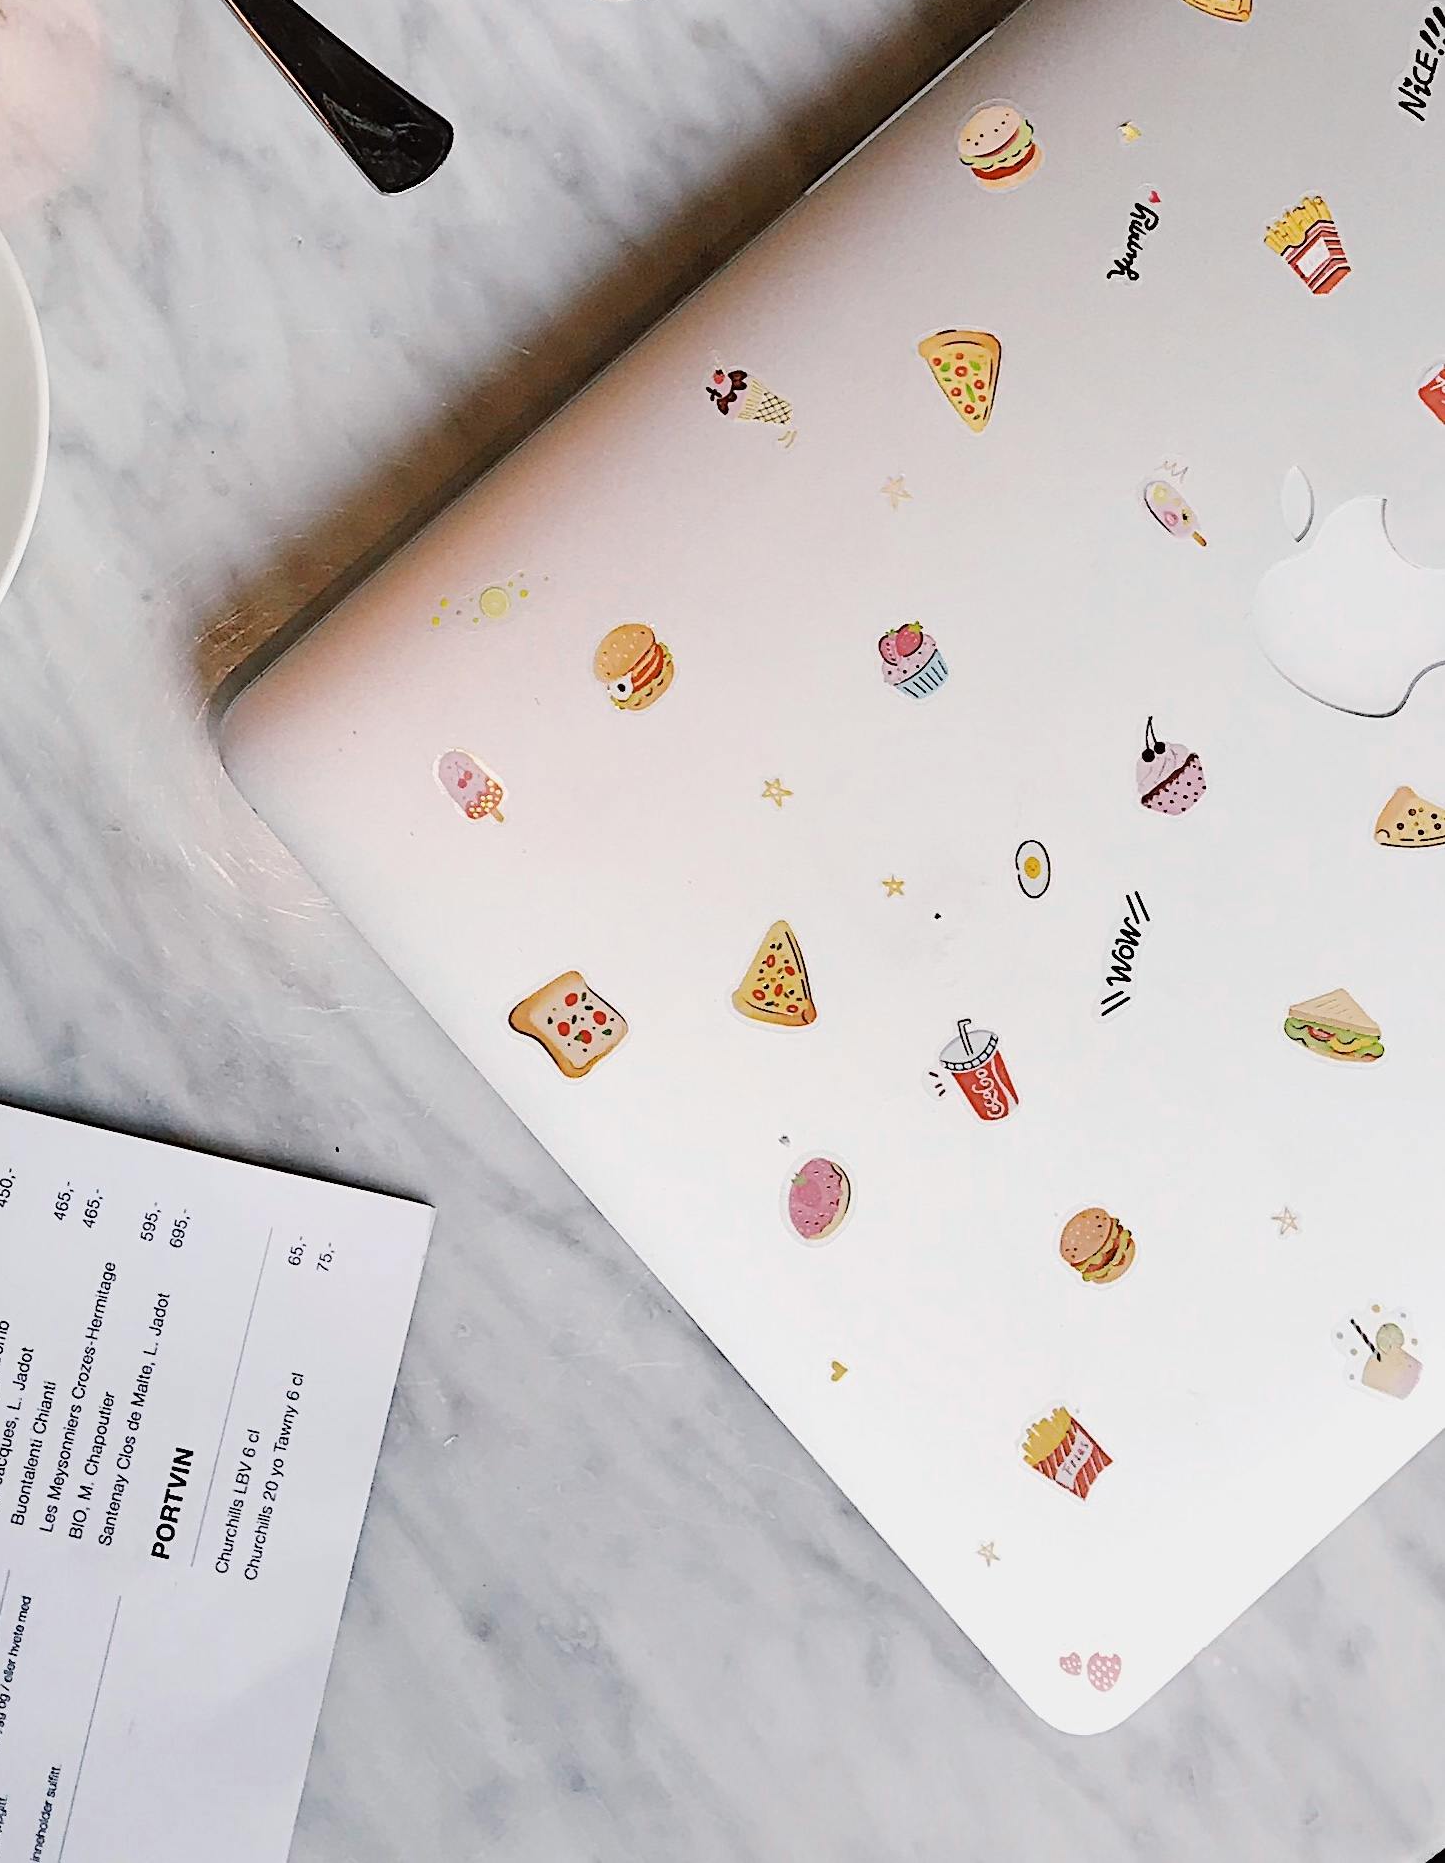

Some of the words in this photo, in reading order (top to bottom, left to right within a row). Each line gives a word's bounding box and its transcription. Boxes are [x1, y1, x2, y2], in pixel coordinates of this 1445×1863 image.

[12, 1347, 34, 1391] Jadot
[53, 1181, 75, 1221] 465,-
[46, 1404, 82, 1501] Meysonniers
[71, 1262, 117, 1400] Crozes-Hermitage
[84, 1391, 115, 1476] Chapoutier
[140, 1202, 162, 1242] 595,-
[98, 1474, 129, 1546] Santenay
[130, 1362, 156, 1407] Malte,
[169, 1209, 191, 1248] 695,-
[215, 1499, 244, 1574] Churchills
[233, 1461, 252, 1495] LBV
[287, 1236, 307, 1266] 65,-
[244, 1505, 273, 1581] Churchills
[273, 1404, 299, 1453] Tawny
[316, 1242, 335, 1272] 75,-
[10, 1438, 43, 1526] Buontalenti
[30, 1380, 57, 1435] Chianti
[150, 1447, 194, 1560] PORTVIN
